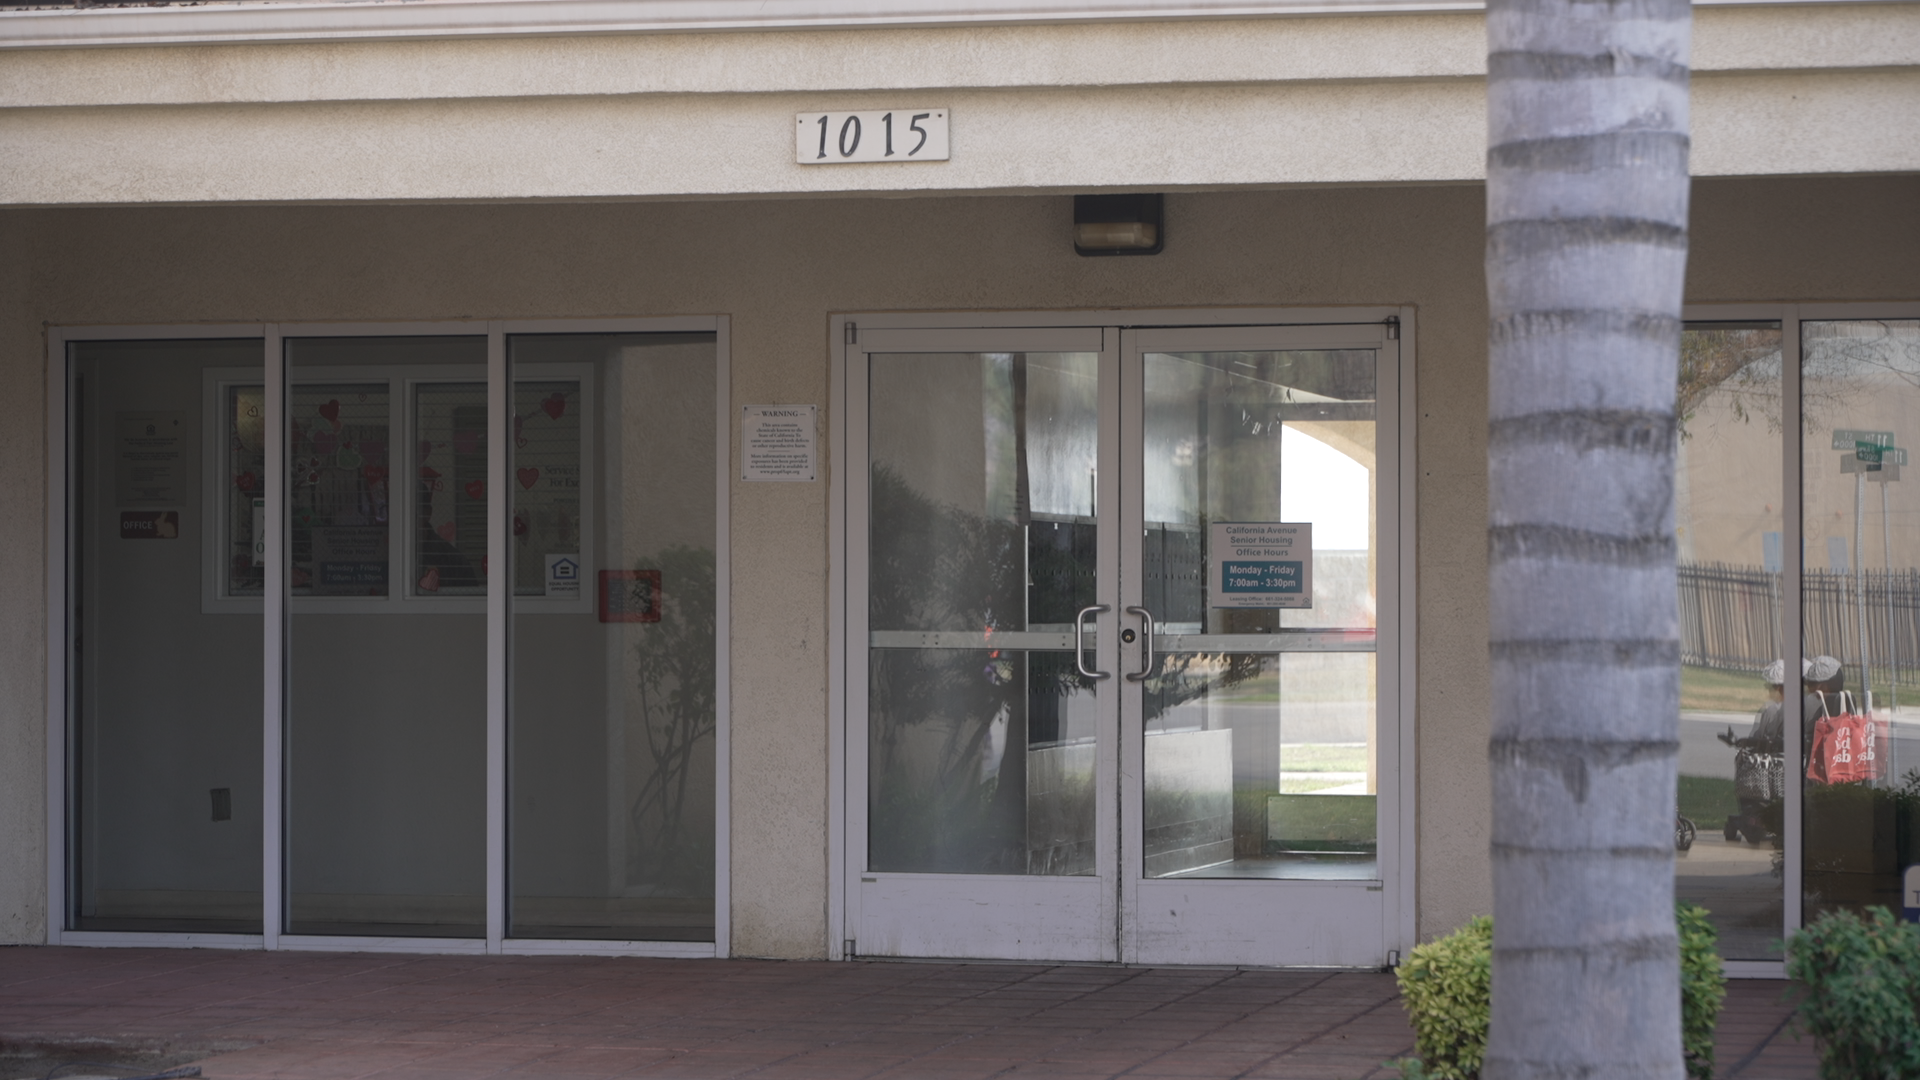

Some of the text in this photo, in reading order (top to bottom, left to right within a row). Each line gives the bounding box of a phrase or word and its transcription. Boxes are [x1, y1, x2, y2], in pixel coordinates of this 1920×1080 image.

[123, 521, 152, 529] OFFICE
[1259, 536, 1293, 545] Housing
[1230, 566, 1262, 576] Monday
[1269, 566, 1295, 576] Friday
[1229, 578, 1258, 587] 7:00am
[1266, 578, 1296, 588] 3:30pm
